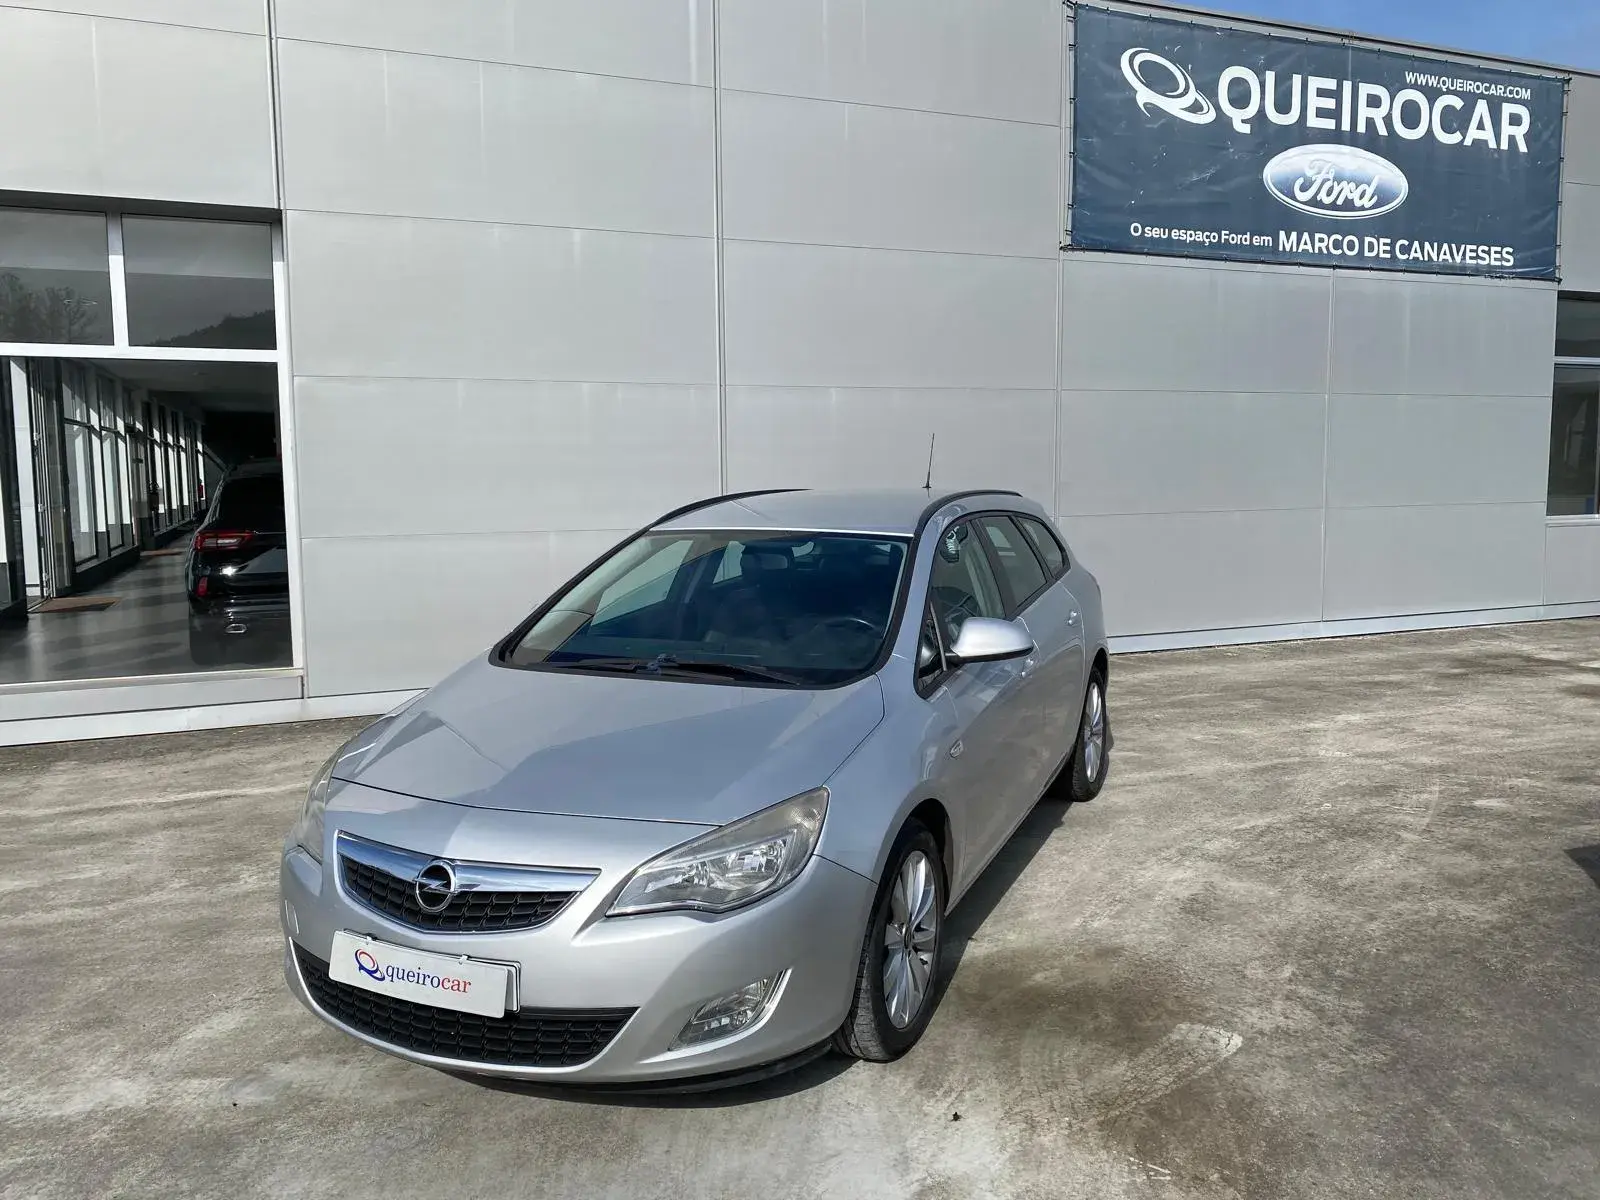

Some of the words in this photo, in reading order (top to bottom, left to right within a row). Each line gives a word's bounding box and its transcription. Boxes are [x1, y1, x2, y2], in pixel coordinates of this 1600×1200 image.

[1405, 71, 1531, 100] WWW.QUEIROCAR.COM
[1217, 65, 1531, 153] QUEIROCAR
[1293, 159, 1378, 208] Ford
[1130, 222, 1142, 236] O
[1144, 226, 1169, 238] seu
[1171, 229, 1219, 246] espaço
[1221, 230, 1250, 246] Ford
[1252, 234, 1273, 247] em
[1278, 230, 1359, 256] MARCO
[1364, 236, 1391, 258] DE
[1395, 239, 1514, 267] CANAVESES
[385, 964, 472, 994] queirocar
